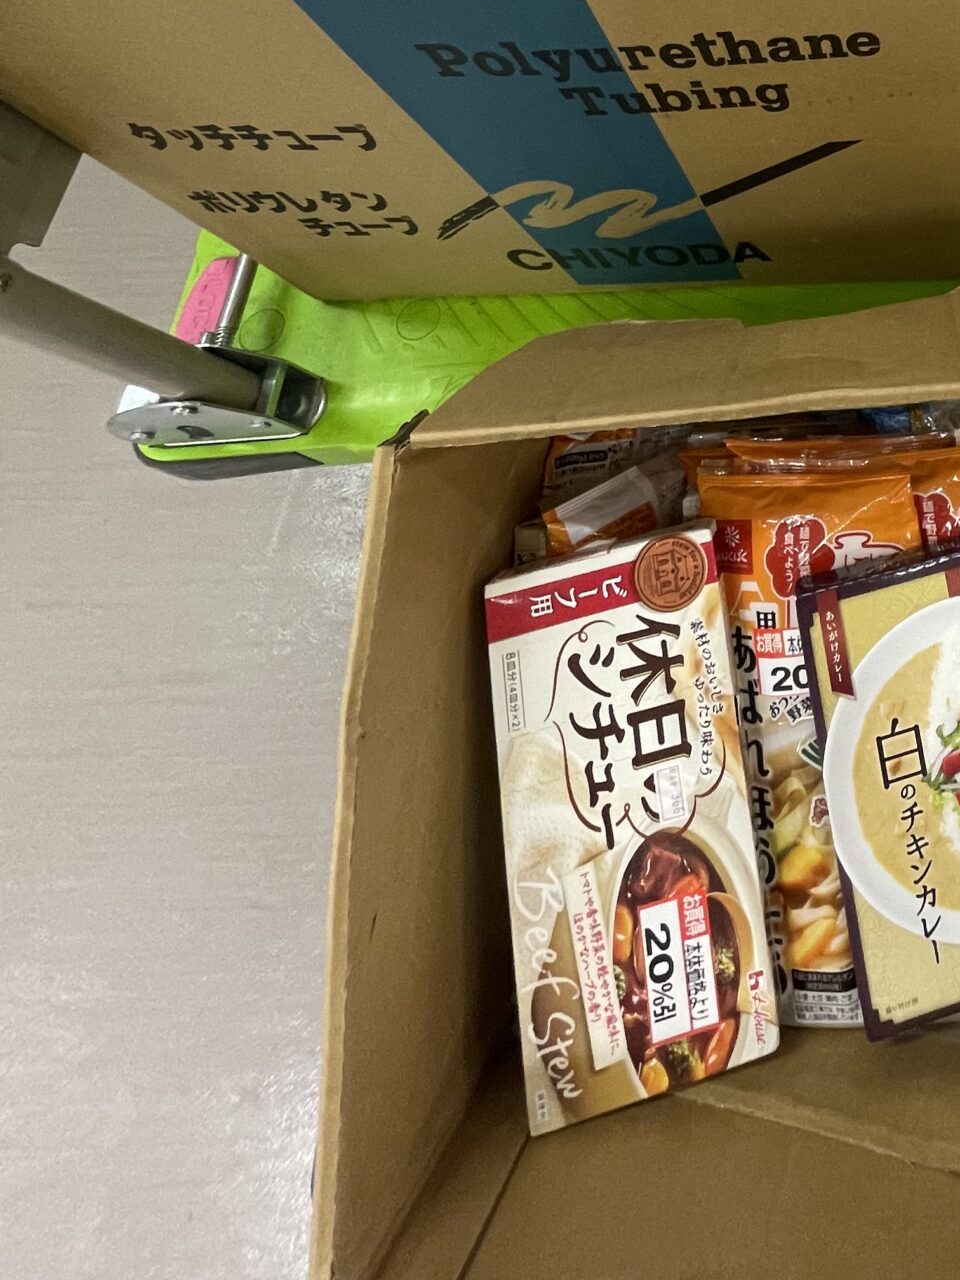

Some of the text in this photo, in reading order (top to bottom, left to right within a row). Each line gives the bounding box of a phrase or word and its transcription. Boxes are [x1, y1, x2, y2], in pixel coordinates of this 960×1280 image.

[414, 31, 881, 82] Polyurethane
[560, 80, 791, 116] Tubing
[506, 241, 773, 270] CHIYODA
[530, 575, 628, 618] ビーフ用
[756, 634, 784, 653] お買得
[825, 610, 843, 684] あいがけカレー
[568, 643, 626, 850] シチュー
[693, 675, 716, 777] ゆったり味わう
[875, 717, 943, 966] 白のチキンカレー
[682, 894, 708, 936] お買得
[515, 865, 583, 1099] Beef Stew
[644, 922, 677, 1024] 20%引
[684, 941, 711, 1022] 本体価格より
